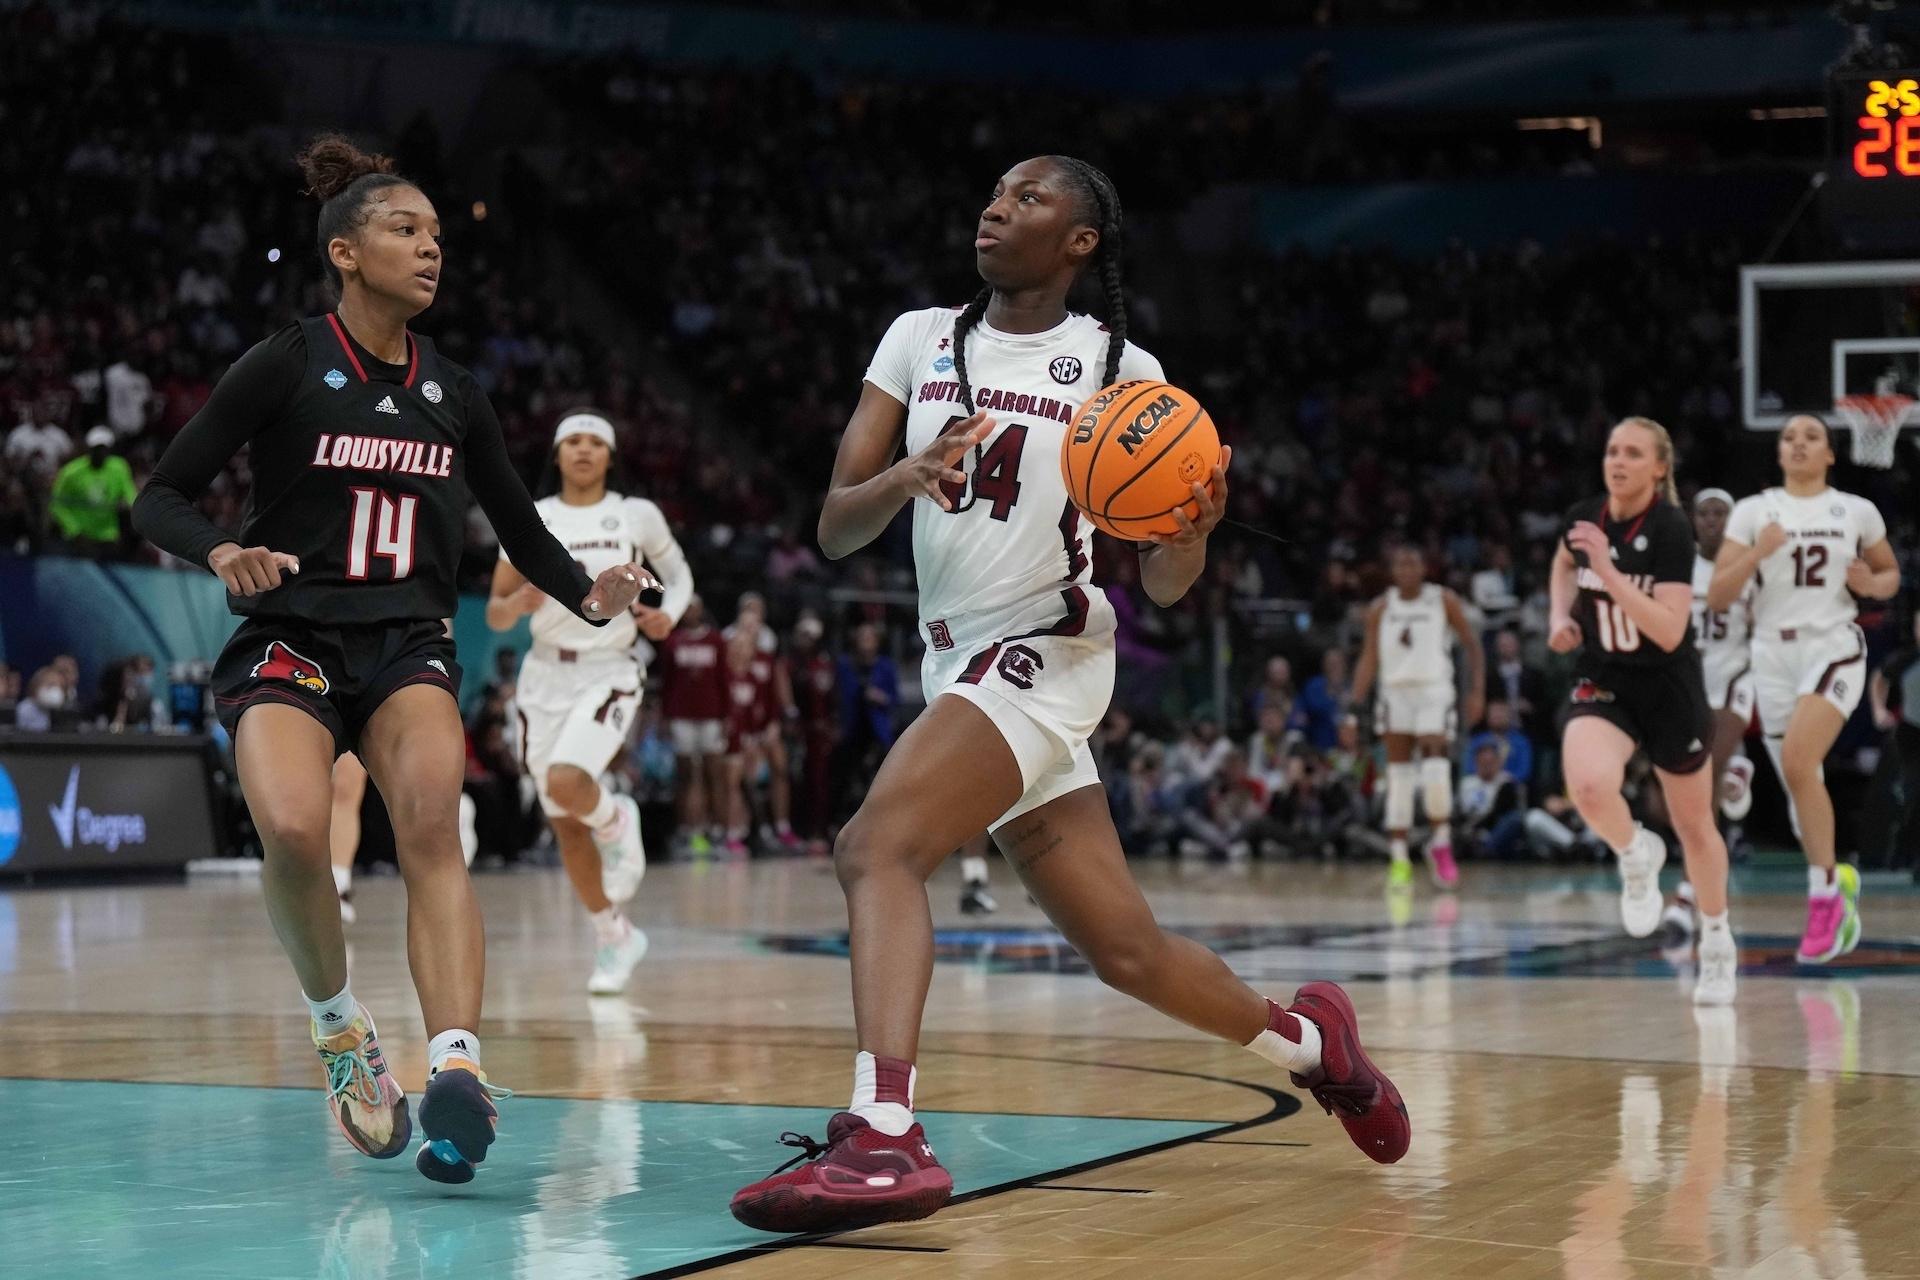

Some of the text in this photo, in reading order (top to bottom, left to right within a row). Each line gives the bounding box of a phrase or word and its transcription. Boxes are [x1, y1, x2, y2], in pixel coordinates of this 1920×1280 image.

[1051, 357, 1079, 382] SEC
[375, 405, 400, 415] adidas
[975, 387, 1073, 426] CAROLINA
[1116, 393, 1182, 456] NCAA
[311, 433, 453, 478] LOUISVILLE
[345, 486, 420, 582] 14
[1791, 544, 1829, 588] 12
[77, 806, 146, 853] Degree
